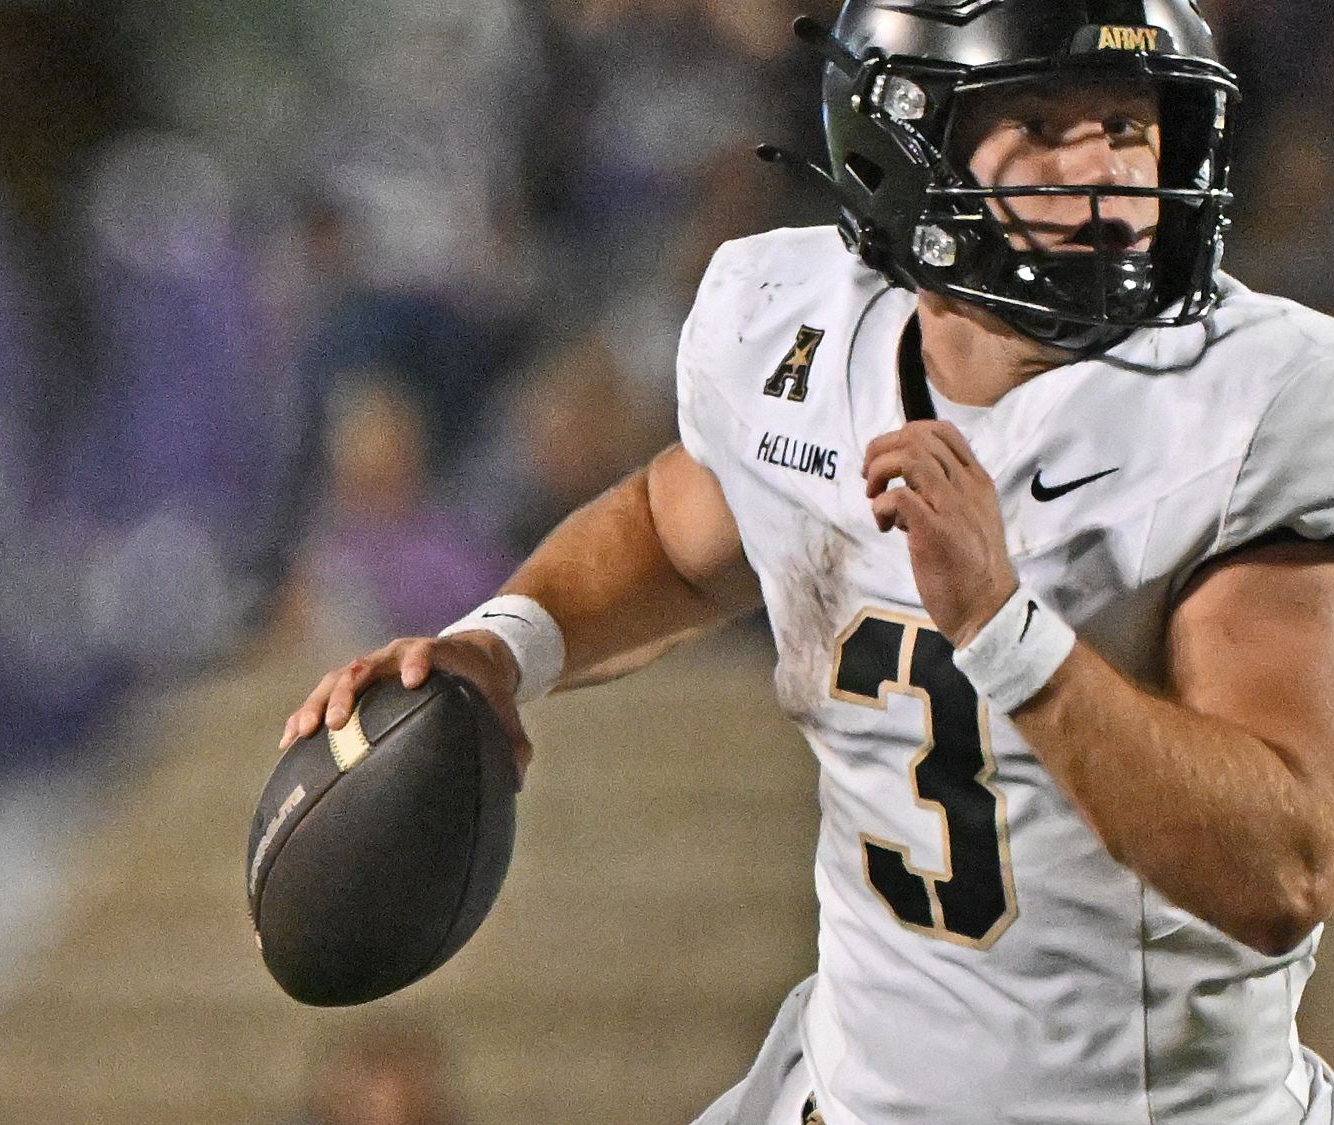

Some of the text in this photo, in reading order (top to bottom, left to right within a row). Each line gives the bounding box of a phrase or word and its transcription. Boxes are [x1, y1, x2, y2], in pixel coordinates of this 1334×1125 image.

[1097, 25, 1158, 51] ARMY
[756, 431, 839, 481] HELLUMS
[829, 606, 1019, 951] 3
